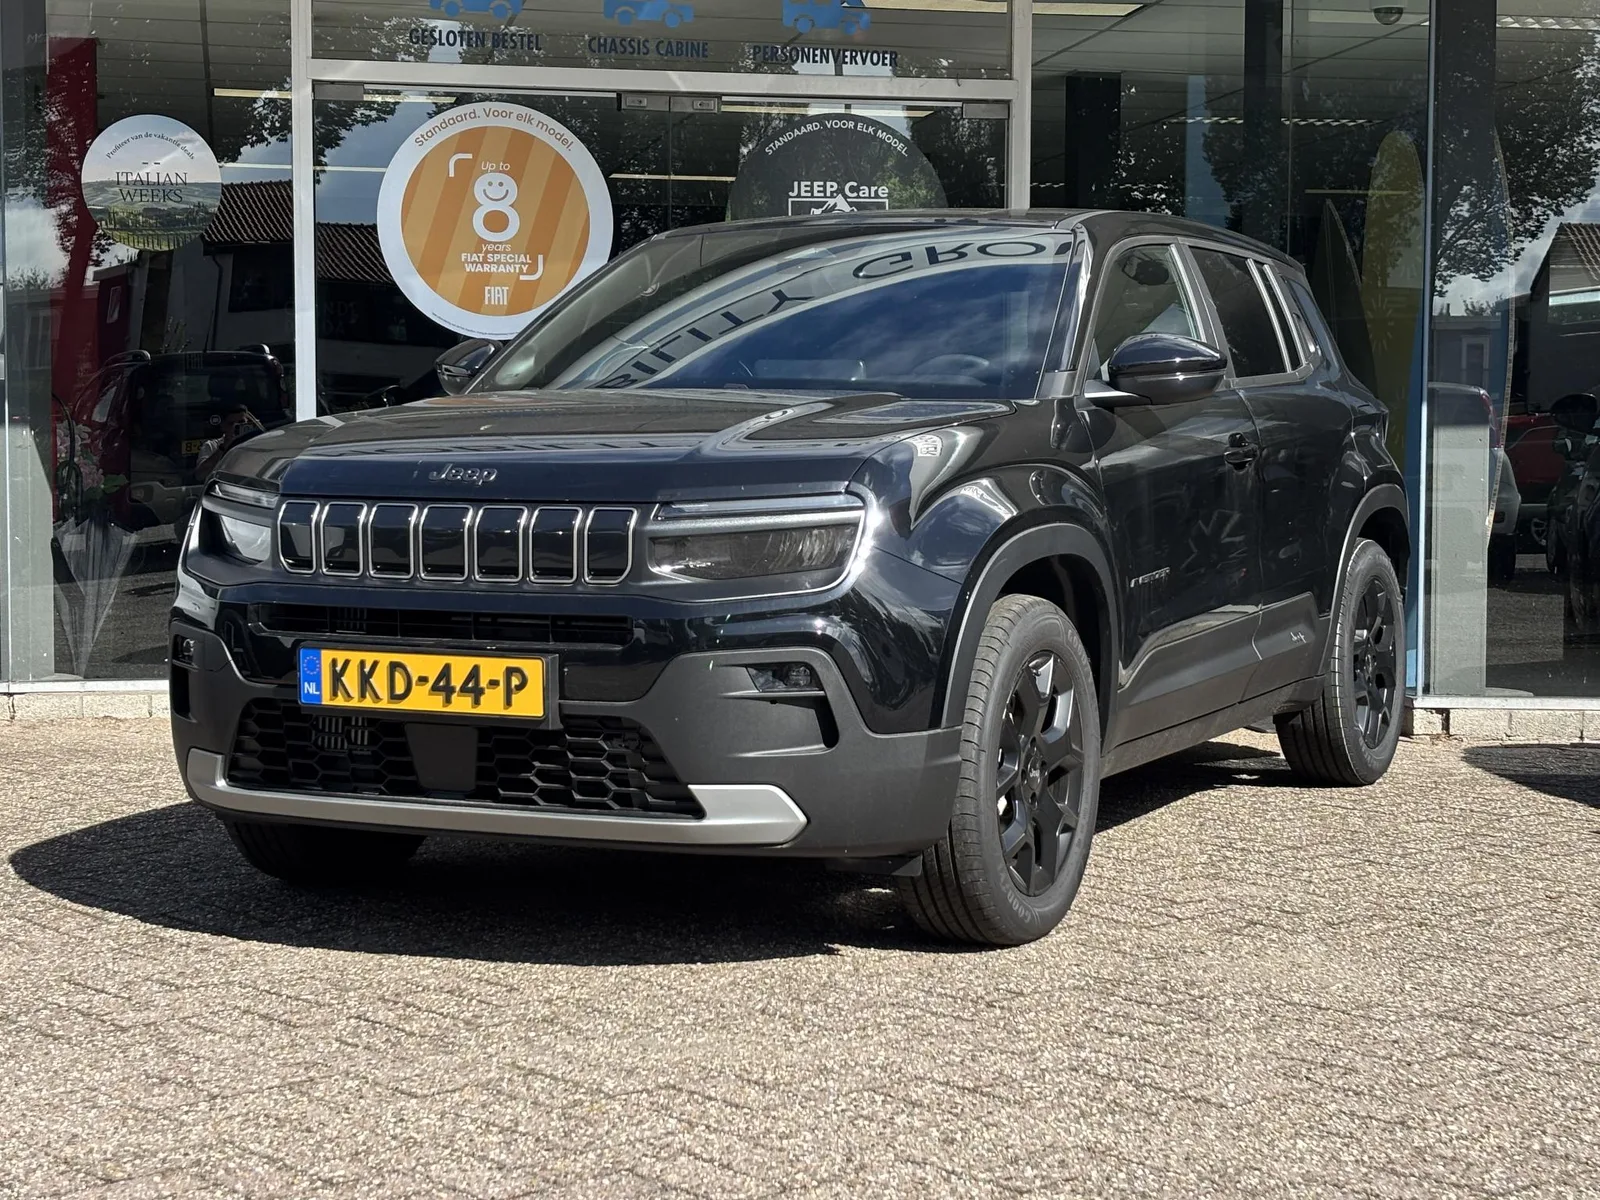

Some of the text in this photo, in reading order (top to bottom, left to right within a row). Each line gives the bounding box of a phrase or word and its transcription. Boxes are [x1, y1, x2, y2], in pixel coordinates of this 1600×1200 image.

[409, 28, 542, 51] GESLOTEN BESTEL
[588, 37, 709, 59] CHASSIS CABINE
[753, 44, 898, 68] PERSONENVERVOER
[414, 107, 574, 152] Standaard. Voor elk model.
[765, 122, 823, 156] STANDAARD.
[825, 119, 855, 130] VOOR
[857, 122, 875, 136] ELK
[105, 138, 131, 159] Profiteer
[130, 133, 143, 142] van
[153, 133, 181, 147] vakantie
[180, 144, 195, 160] deals
[481, 161, 511, 172] Up to
[115, 171, 188, 186] ITALIAN
[119, 188, 183, 203] WEEKS
[844, 181, 889, 198] Care
[481, 243, 512, 253] years
[461, 253, 532, 264] FIAT SPECIAL
[464, 263, 529, 273] WARRANTY
[484, 286, 509, 306] FIAT
[428, 463, 498, 485] Jeep
[304, 682, 320, 695] NL
[329, 658, 529, 710] KKD-44-P
